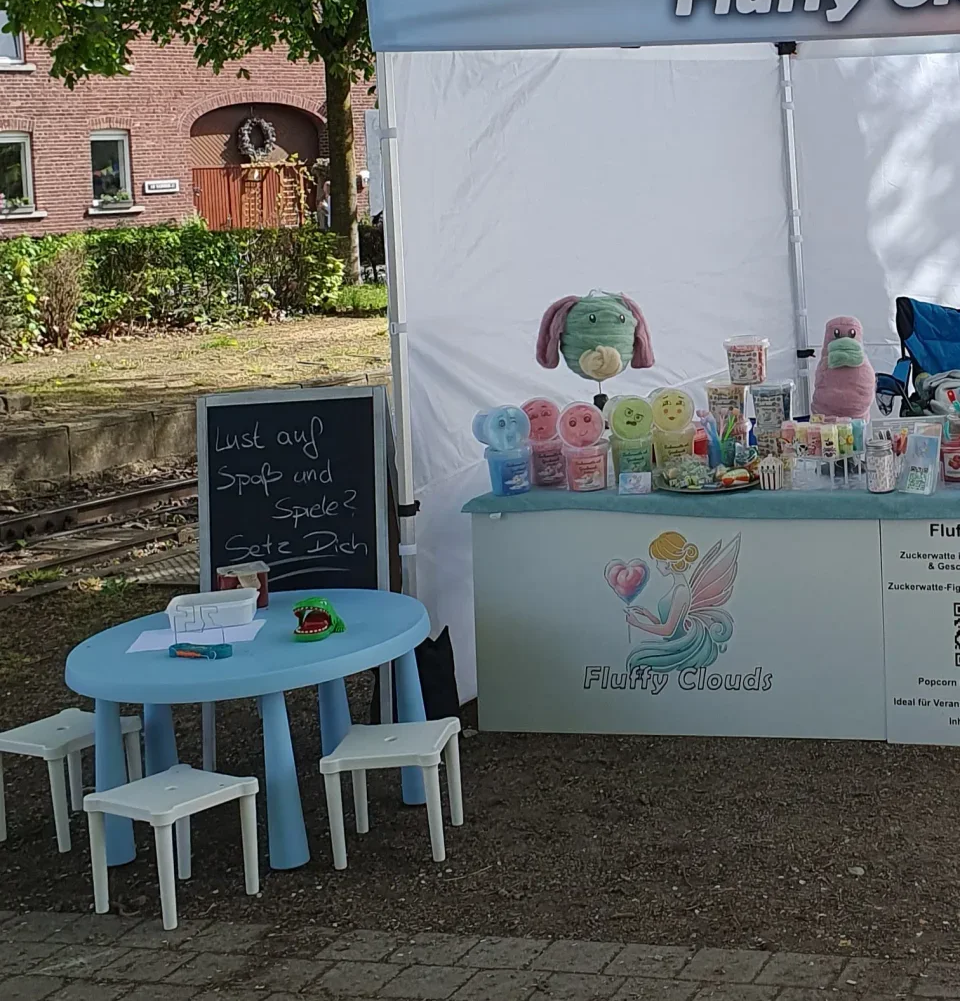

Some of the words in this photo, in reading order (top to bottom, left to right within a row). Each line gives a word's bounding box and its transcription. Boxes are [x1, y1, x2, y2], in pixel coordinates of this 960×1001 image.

[216, 422, 265, 451] Lust
[277, 416, 323, 459] auf
[217, 462, 283, 496] Spaß
[294, 459, 332, 484] und
[225, 534, 292, 561] Setz
[303, 531, 368, 555] Dich
[899, 552, 956, 560] Zuckerwatte
[928, 562, 935, 570] &
[584, 666, 668, 695] Fluffy
[678, 666, 773, 691] Clouds
[918, 678, 957, 687] Popcorn
[893, 698, 916, 706] Ideal
[918, 698, 931, 707] für
